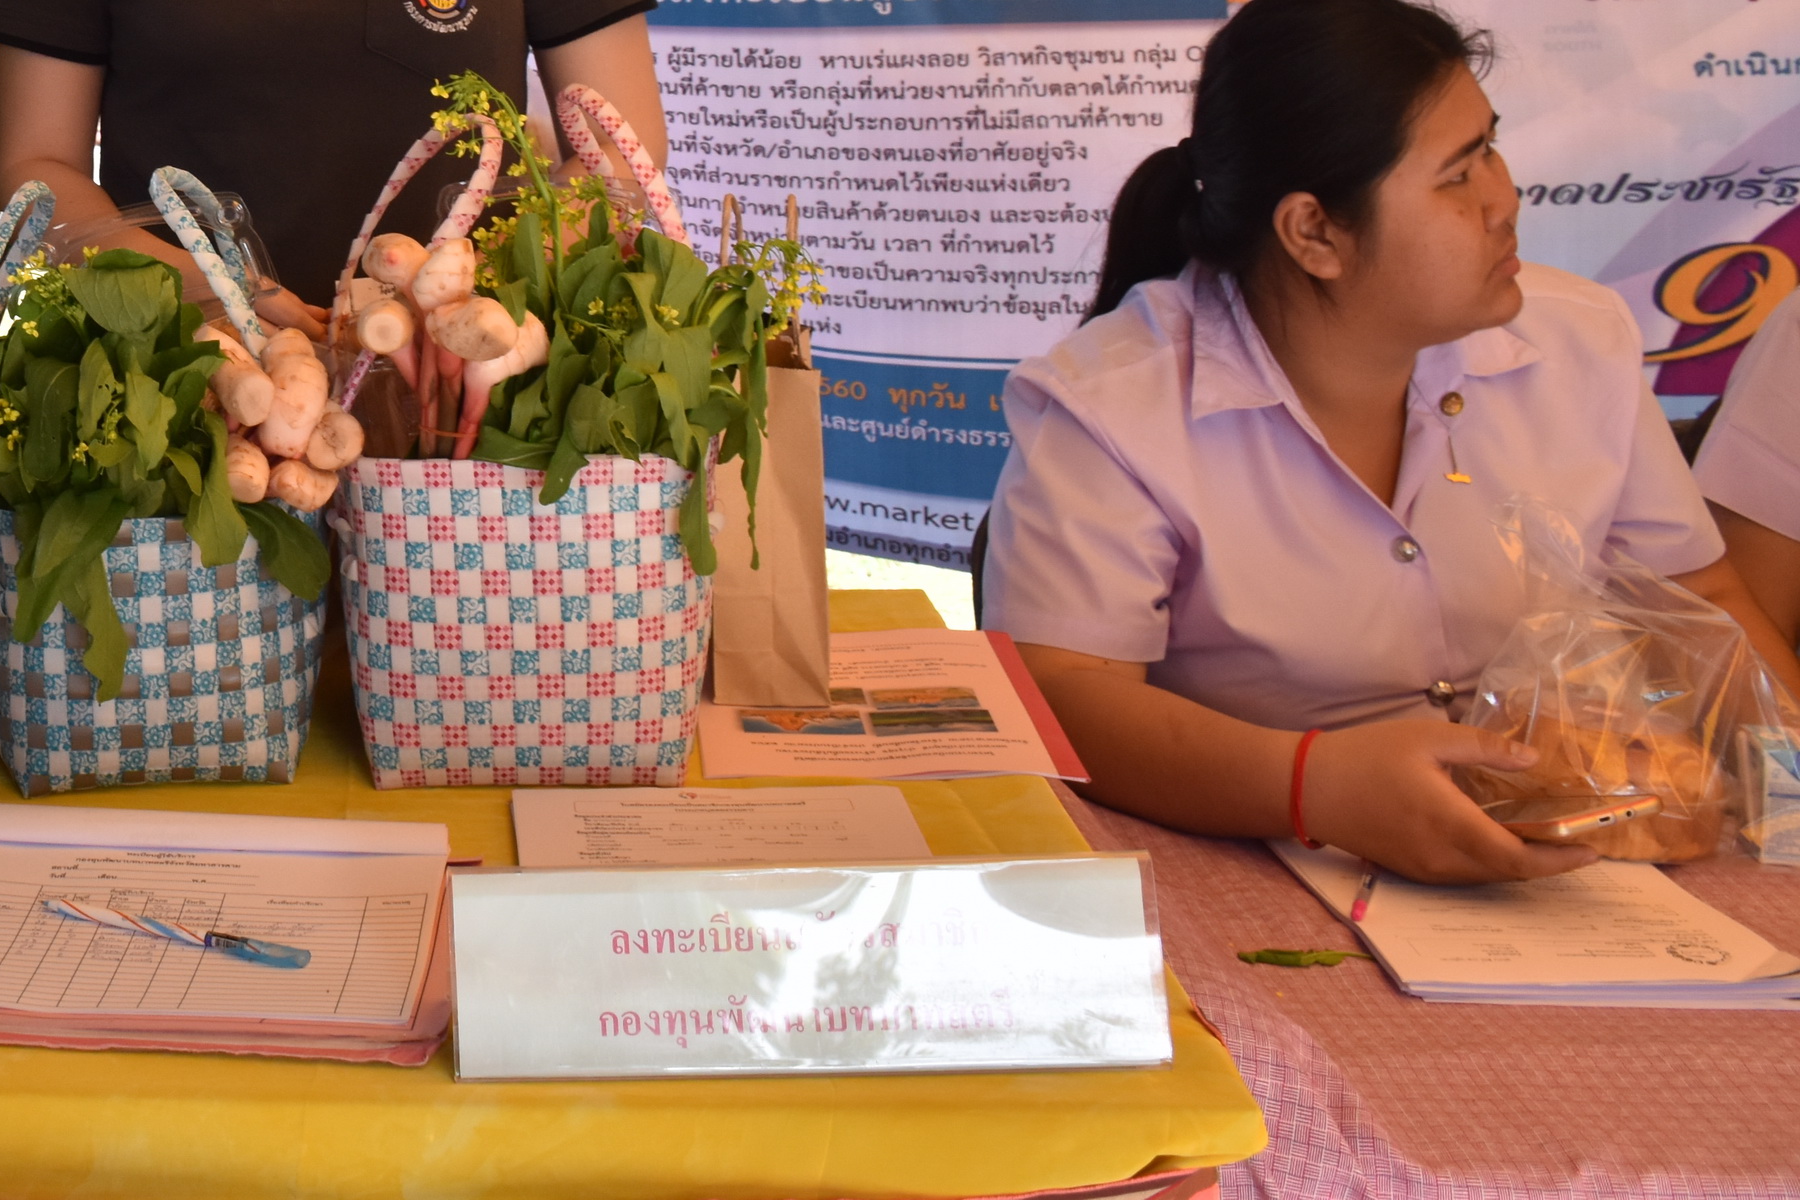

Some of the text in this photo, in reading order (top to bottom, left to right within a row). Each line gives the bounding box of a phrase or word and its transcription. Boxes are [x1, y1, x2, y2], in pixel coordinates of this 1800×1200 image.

[667, 46, 802, 73] ผู้มีรายได้น้อย
[819, 49, 970, 70] หาบเร่แผงลอย
[978, 45, 1125, 72] วิสาหกิจชุมชน
[1134, 43, 1177, 70] กลุ่ม
[884, 236, 932, 252] เวลา
[940, 229, 1055, 254] ที่กำหนดไว้
[888, 382, 967, 414] ทุกวัน
